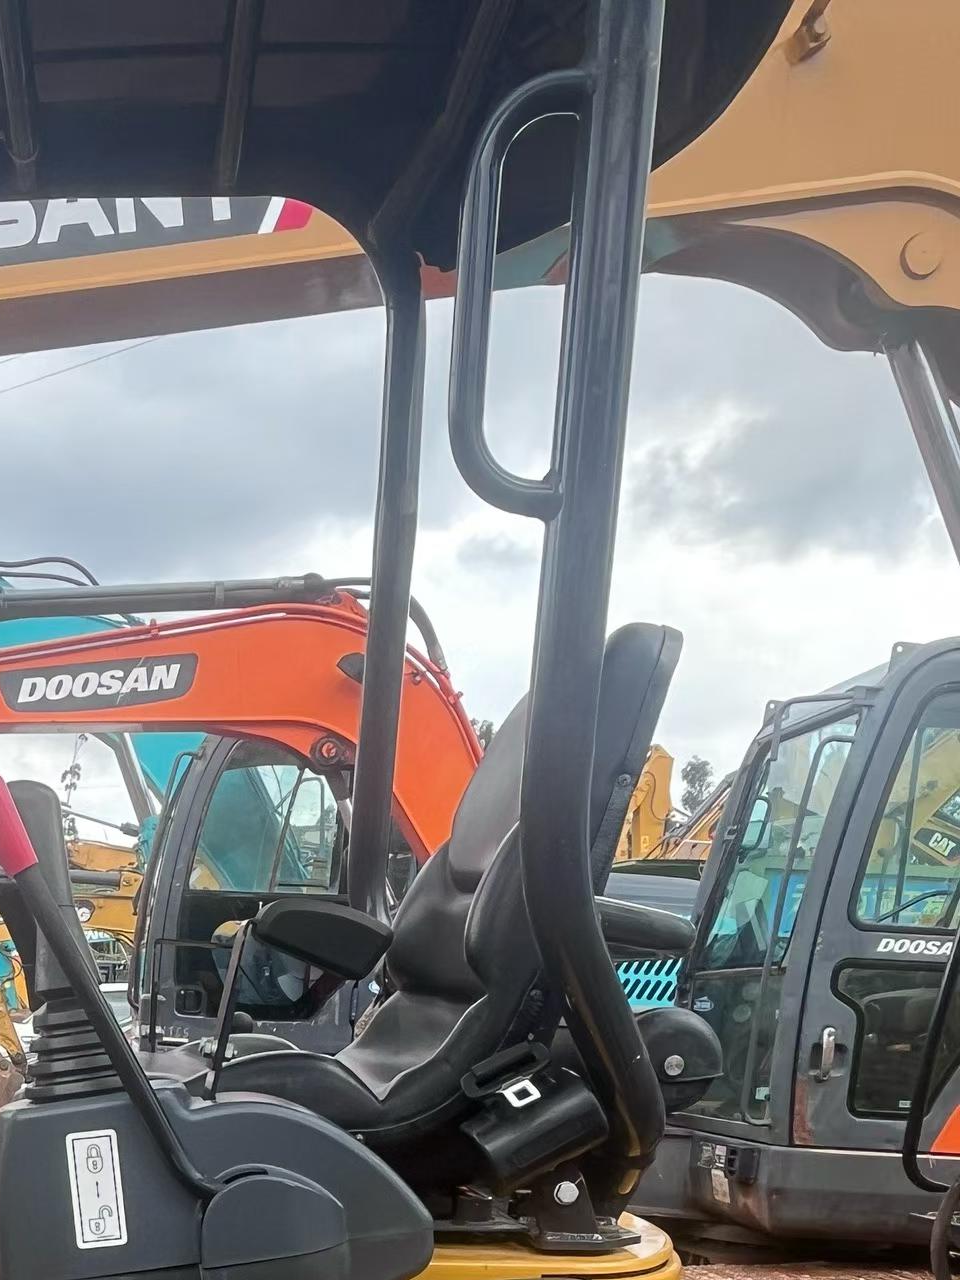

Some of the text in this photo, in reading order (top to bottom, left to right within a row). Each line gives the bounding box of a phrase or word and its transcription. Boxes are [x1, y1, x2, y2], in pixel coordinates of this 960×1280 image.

[17, 663, 181, 703] DOOSAN
[929, 832, 957, 857] CAT
[876, 938, 954, 956] DOOSA
